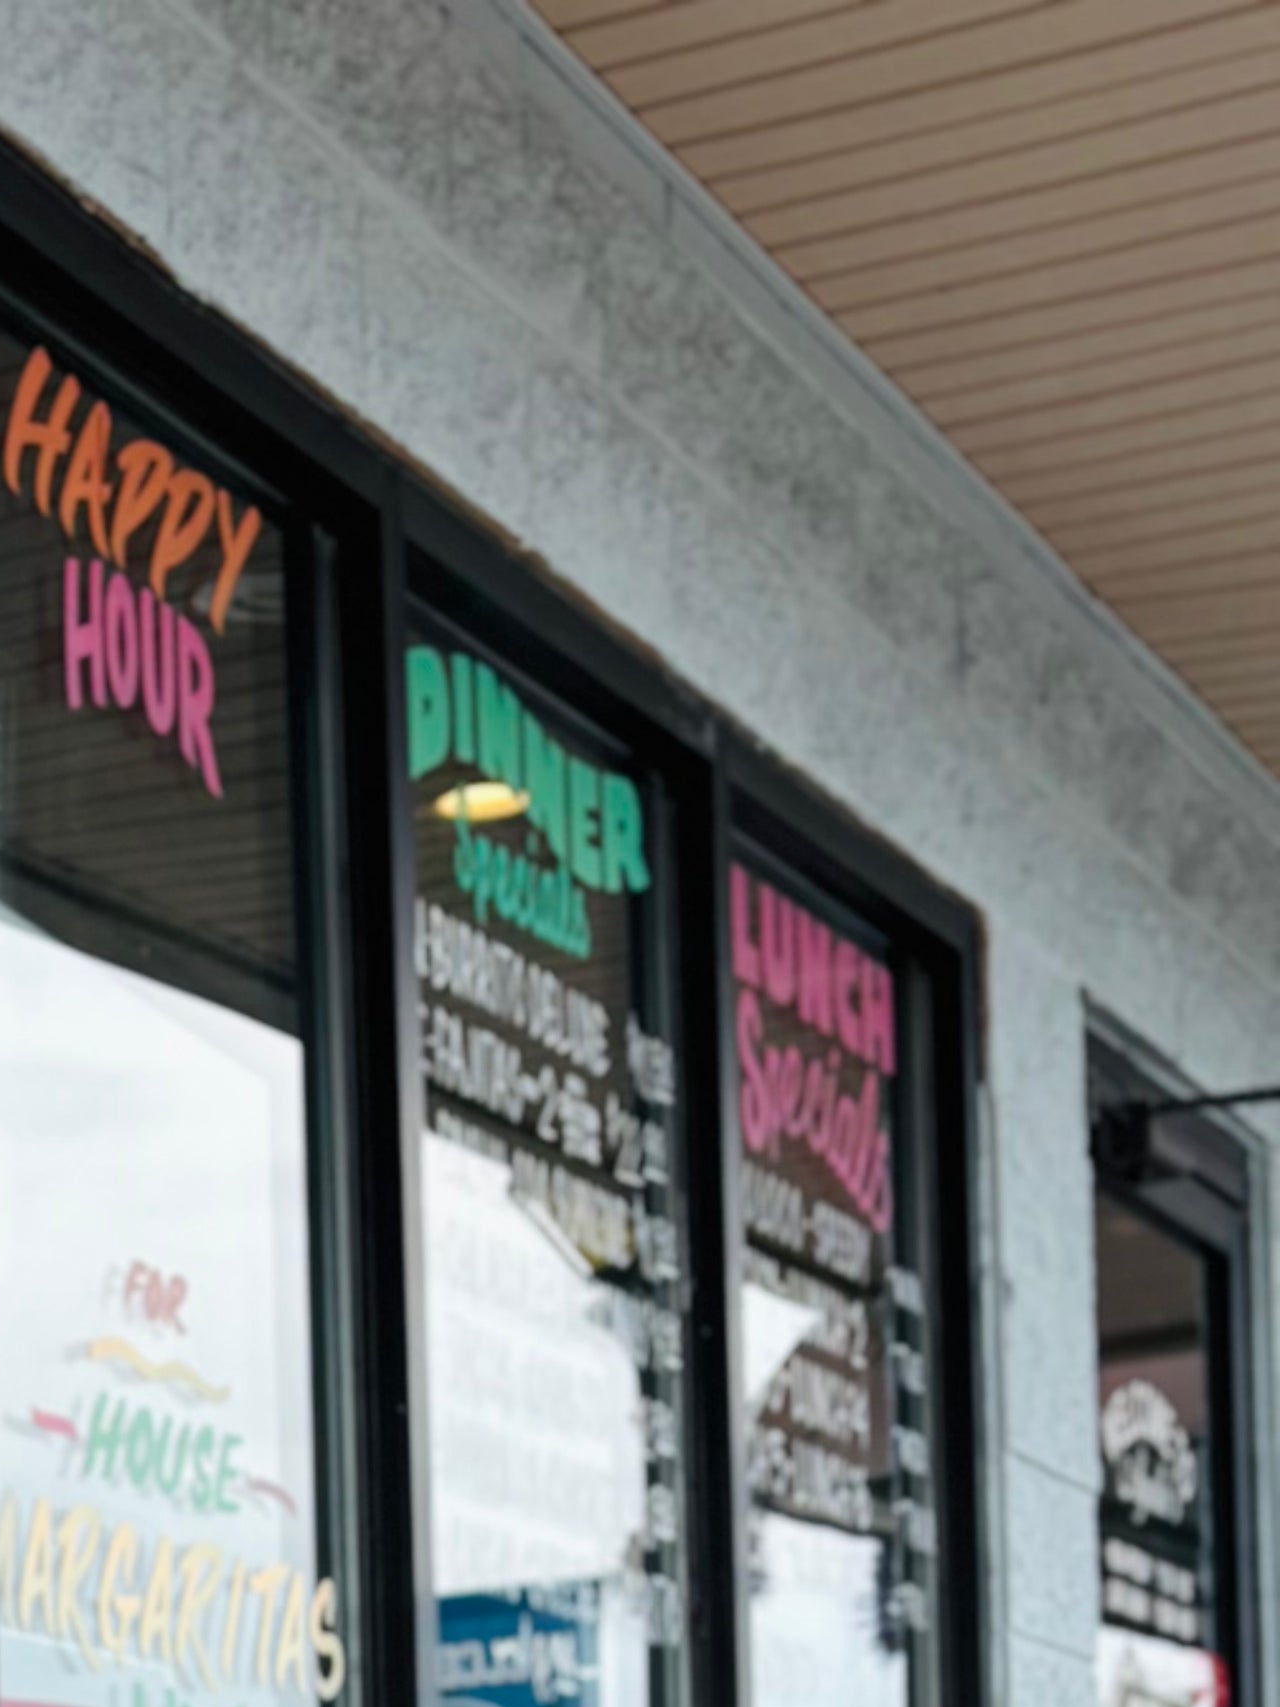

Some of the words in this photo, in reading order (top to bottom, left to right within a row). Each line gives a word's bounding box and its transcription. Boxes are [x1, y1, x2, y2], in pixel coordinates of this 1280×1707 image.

[4, 347, 262, 636] HAPPY
[62, 556, 223, 799] HOUR
[404, 644, 651, 894] DINNER
[728, 860, 896, 1077] LUNCH
[735, 986, 895, 1234] Specials
[124, 1261, 188, 1334] FOR
[83, 1390, 245, 1513] HOUSE
